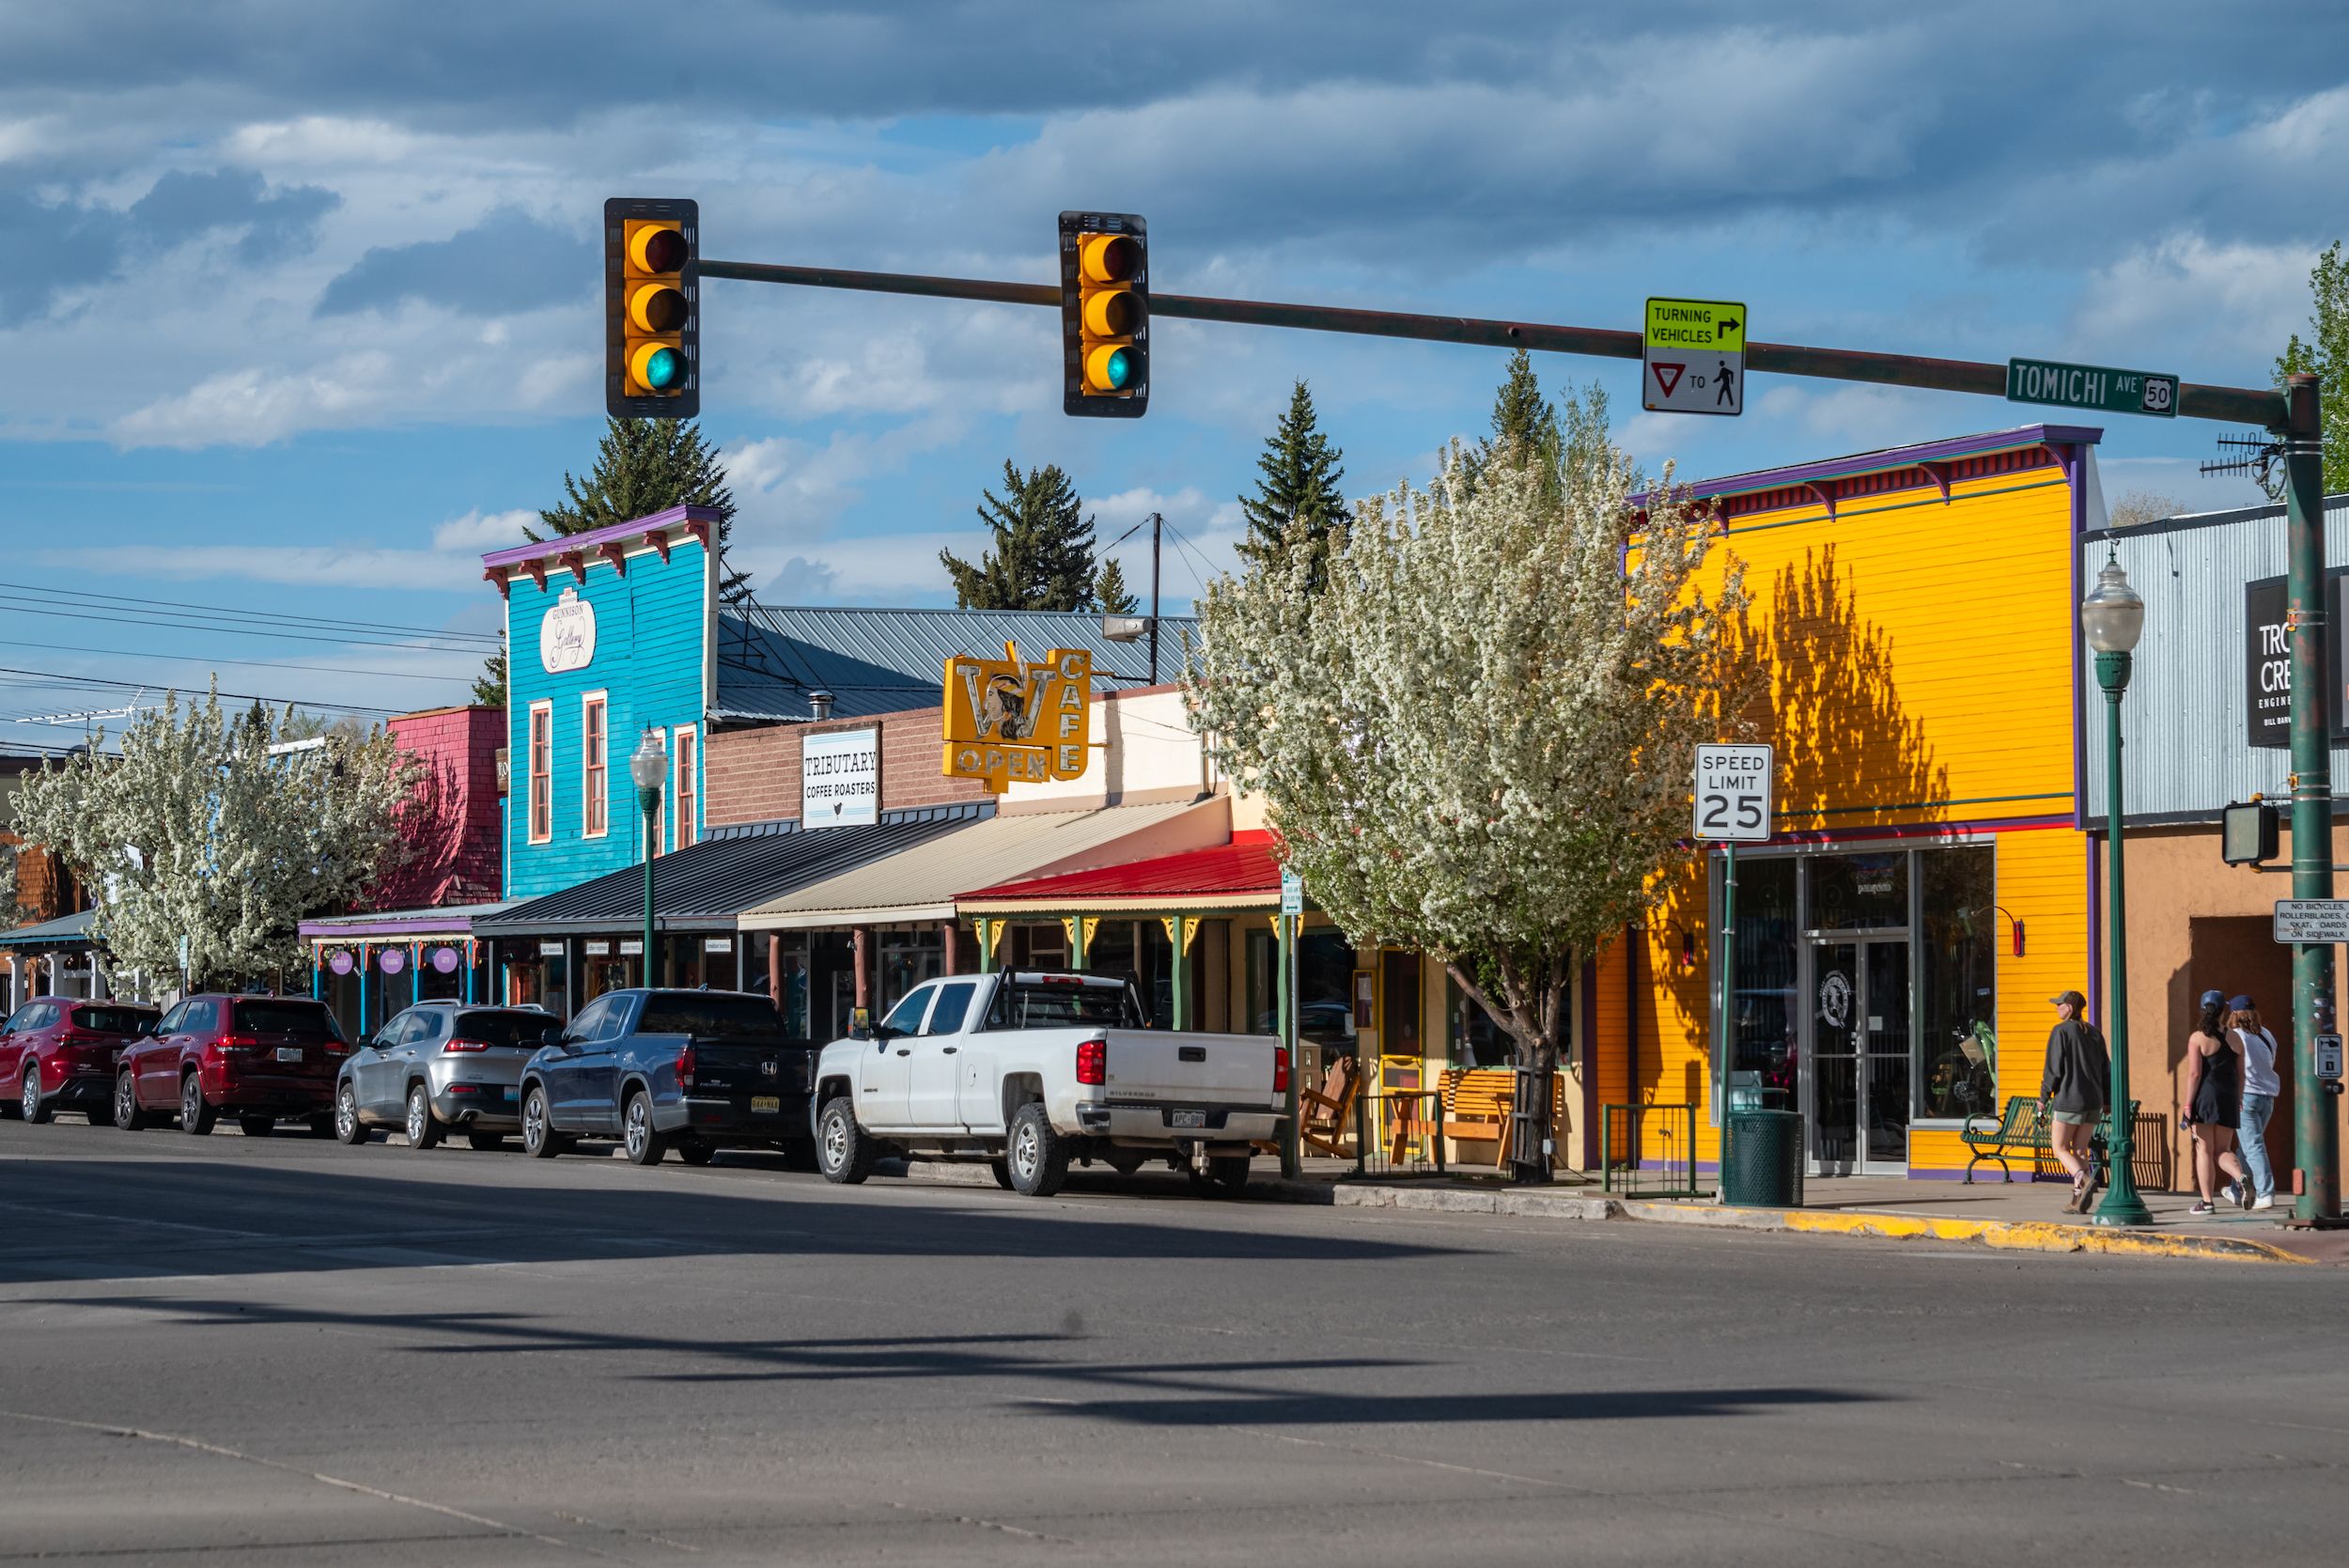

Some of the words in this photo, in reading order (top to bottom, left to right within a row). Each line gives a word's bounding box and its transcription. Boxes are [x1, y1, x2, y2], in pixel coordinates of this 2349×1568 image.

[1654, 307, 1712, 323] TURNING
[1652, 327, 1713, 344] VEHICLES
[1689, 375, 1705, 389] TO
[2015, 365, 2107, 405] TOMICHI
[2115, 376, 2138, 394] AVE
[2147, 386, 2168, 404] 50
[552, 604, 584, 620] GUNNISON
[1059, 654, 1085, 772] CAFE
[805, 752, 877, 777] TRIBUTARY
[958, 749, 1047, 780] OPEN
[1703, 755, 1765, 770] SPEED
[806, 784, 832, 799] COFFEE
[834, 782, 876, 797] ROASTERS
[1709, 775, 1757, 790] LIMIT
[1702, 794, 1763, 830] 25
